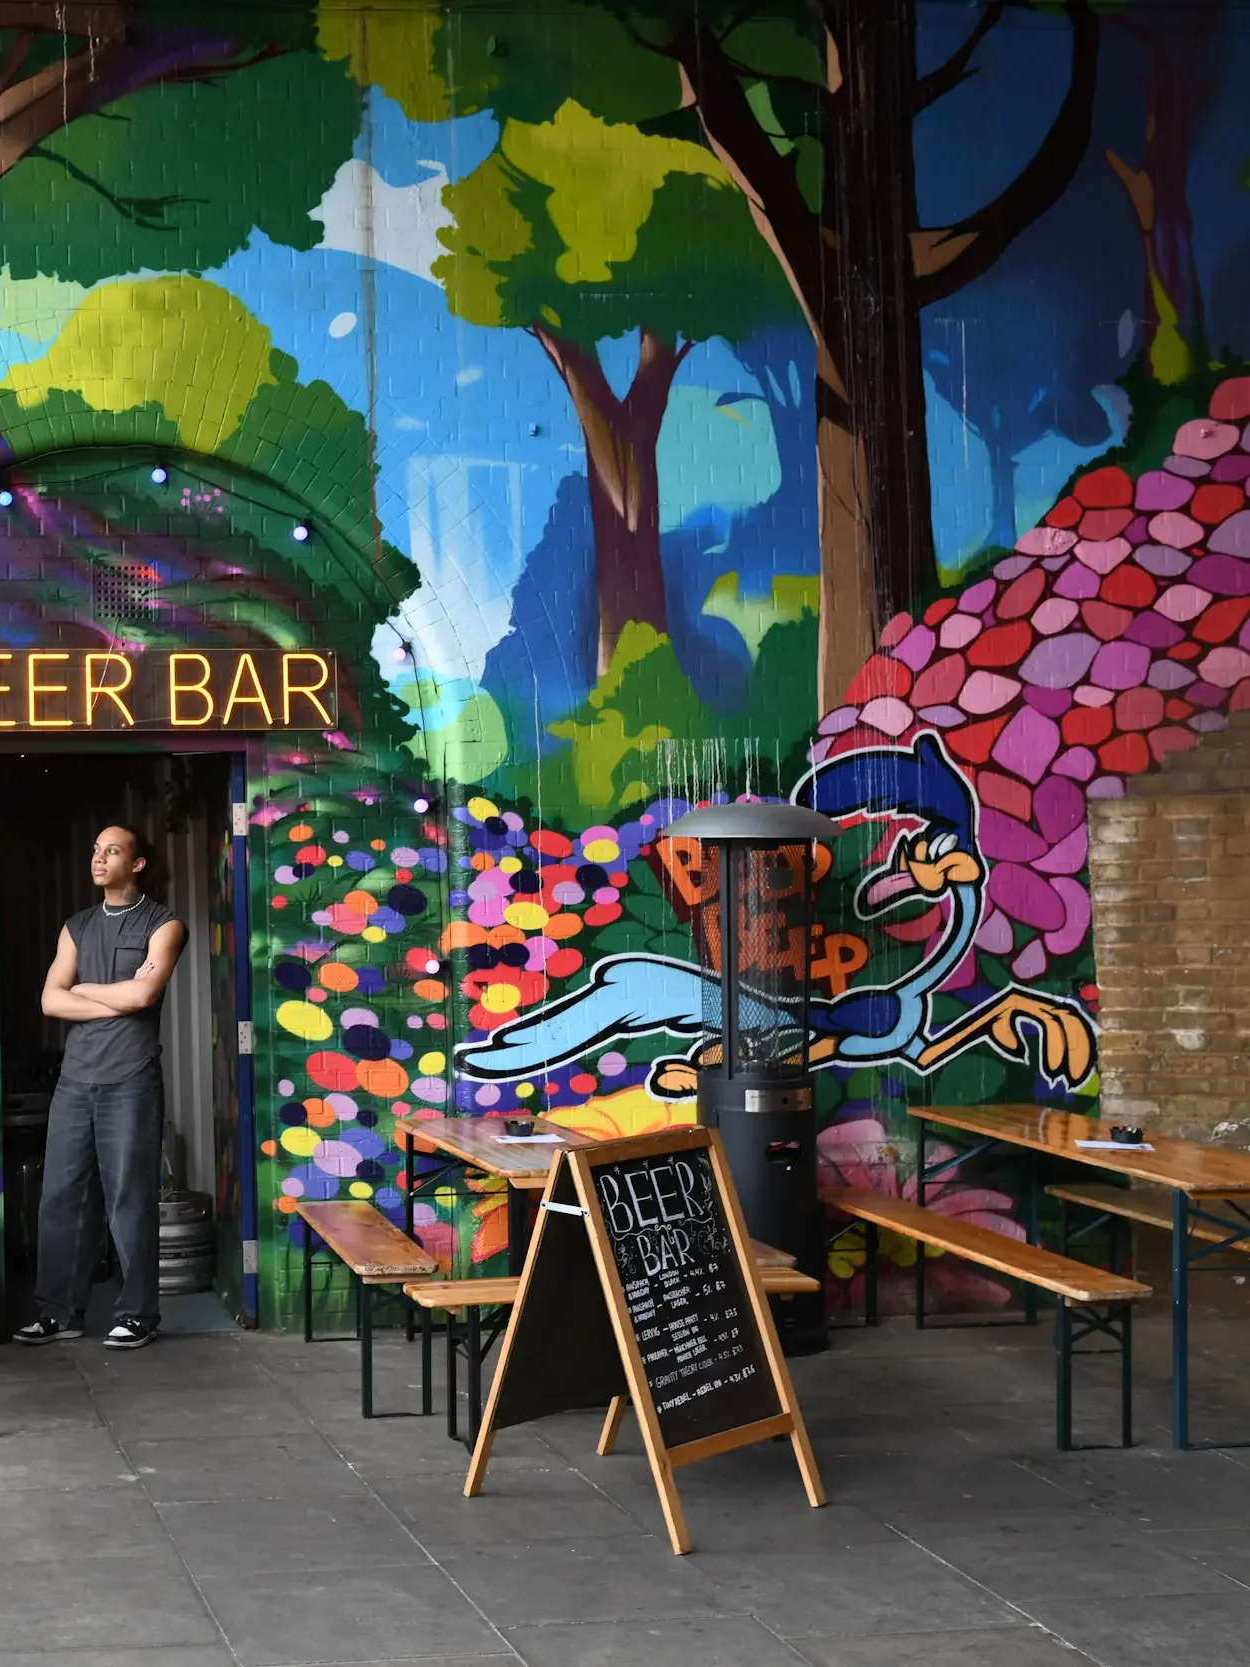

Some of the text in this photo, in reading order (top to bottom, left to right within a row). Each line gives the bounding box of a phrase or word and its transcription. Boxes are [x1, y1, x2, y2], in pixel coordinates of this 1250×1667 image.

[169, 653, 332, 726] BAR
[600, 1161, 704, 1233] BEER
[636, 1228, 695, 1276] BAR
[658, 1269, 679, 1281] LONDON
[668, 1319, 686, 1331] HOUSE
[655, 1370, 678, 1388] GRAVITY
[679, 1363, 698, 1377] THEORY
[698, 1358, 714, 1370] CIDER
[673, 1392, 692, 1406] REBEL
[696, 1382, 714, 1396] REBEL
